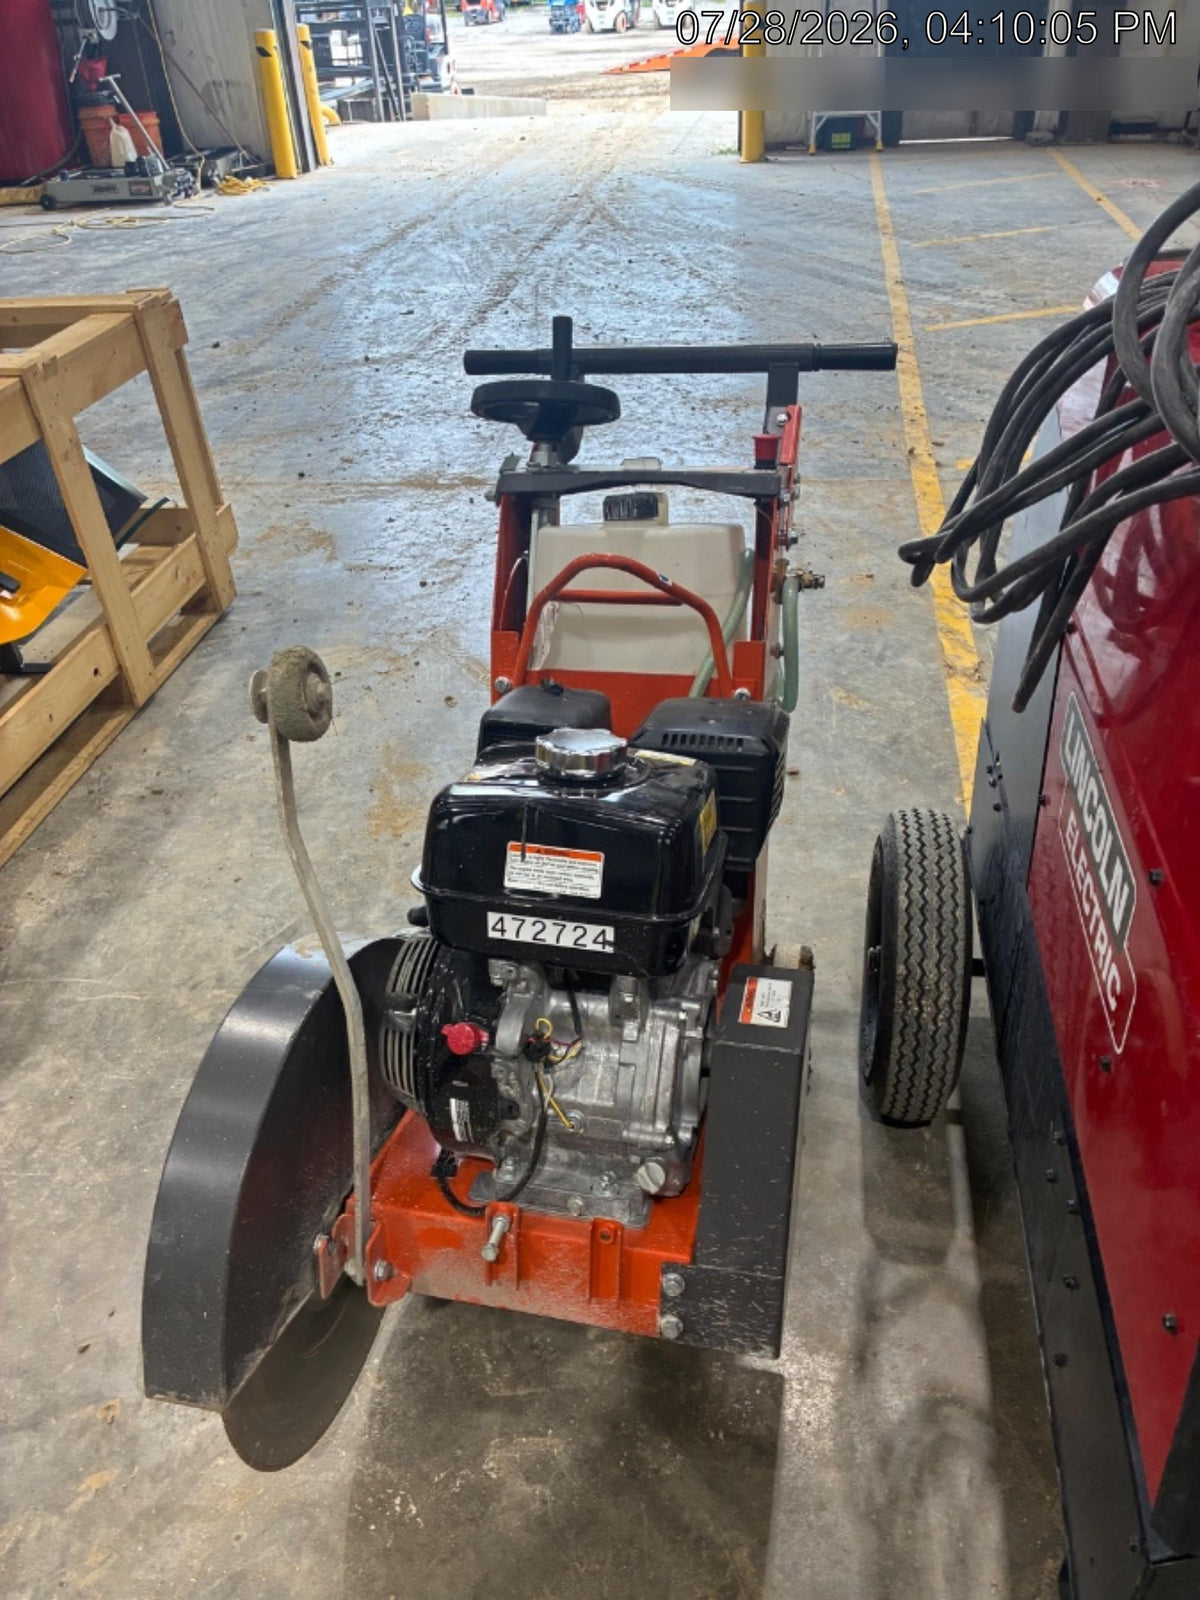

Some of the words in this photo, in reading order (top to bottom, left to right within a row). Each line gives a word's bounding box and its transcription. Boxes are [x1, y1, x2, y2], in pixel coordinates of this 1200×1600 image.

[1065, 711, 1129, 935] LINCOLN
[1066, 809, 1121, 1012] ELECTRIC
[491, 915, 609, 951] 472724
